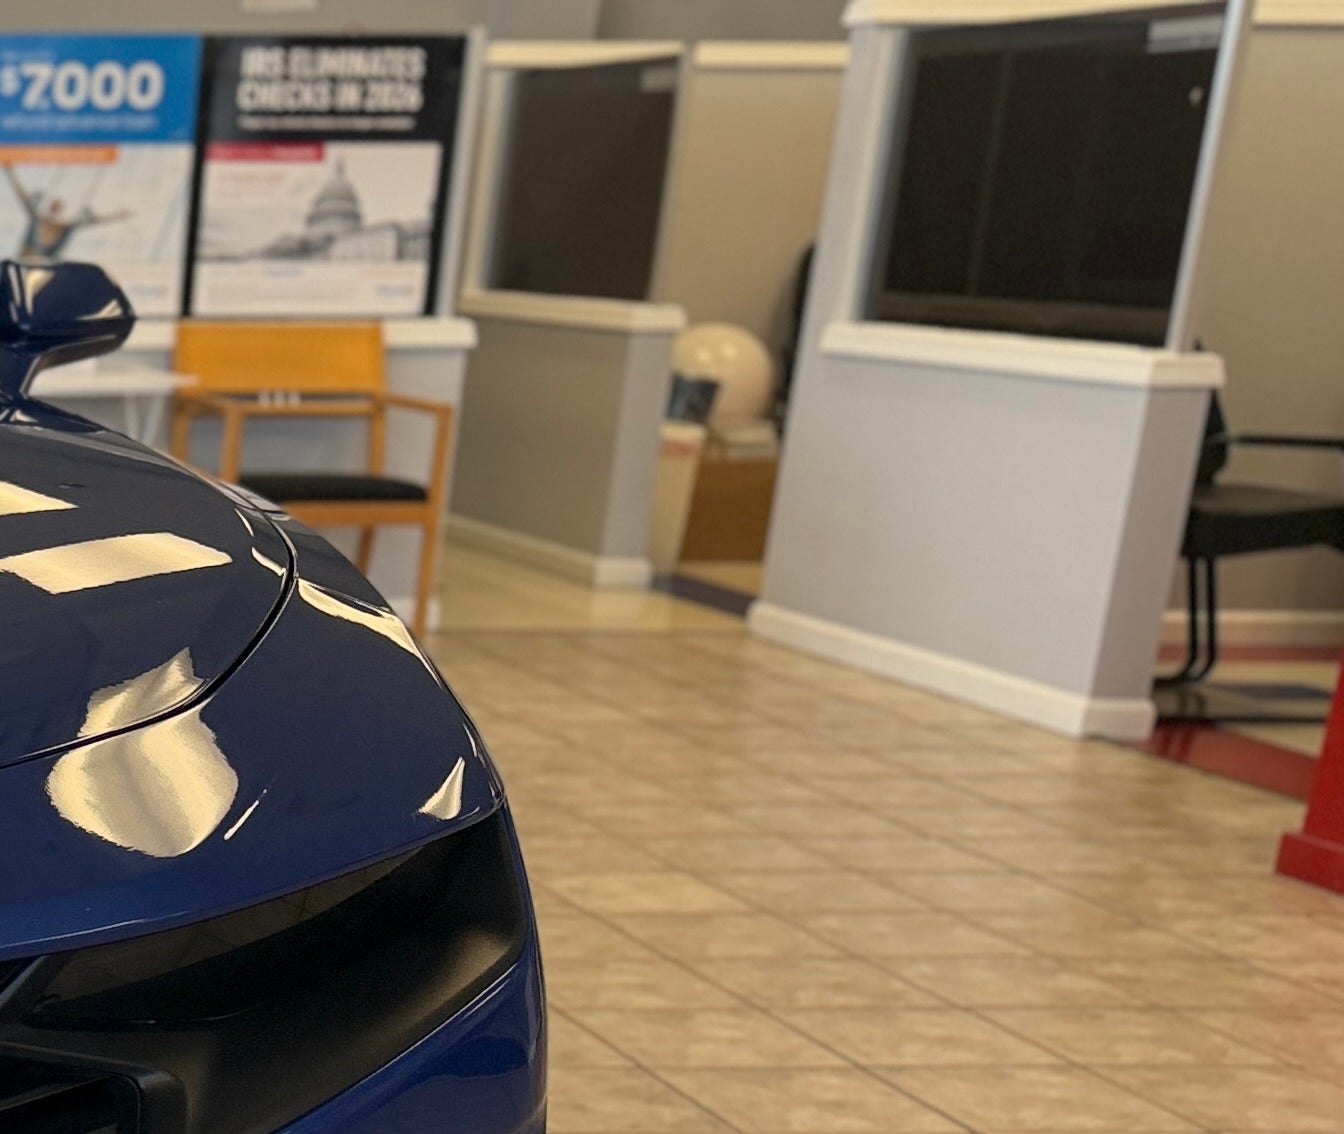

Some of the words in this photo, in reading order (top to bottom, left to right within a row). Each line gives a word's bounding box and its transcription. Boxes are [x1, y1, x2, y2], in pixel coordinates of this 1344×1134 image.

[241, 46, 284, 80] IRS
[288, 46, 427, 80] ELIMINATES
[236, 79, 331, 113] CHECKS
[334, 80, 361, 112] IN
